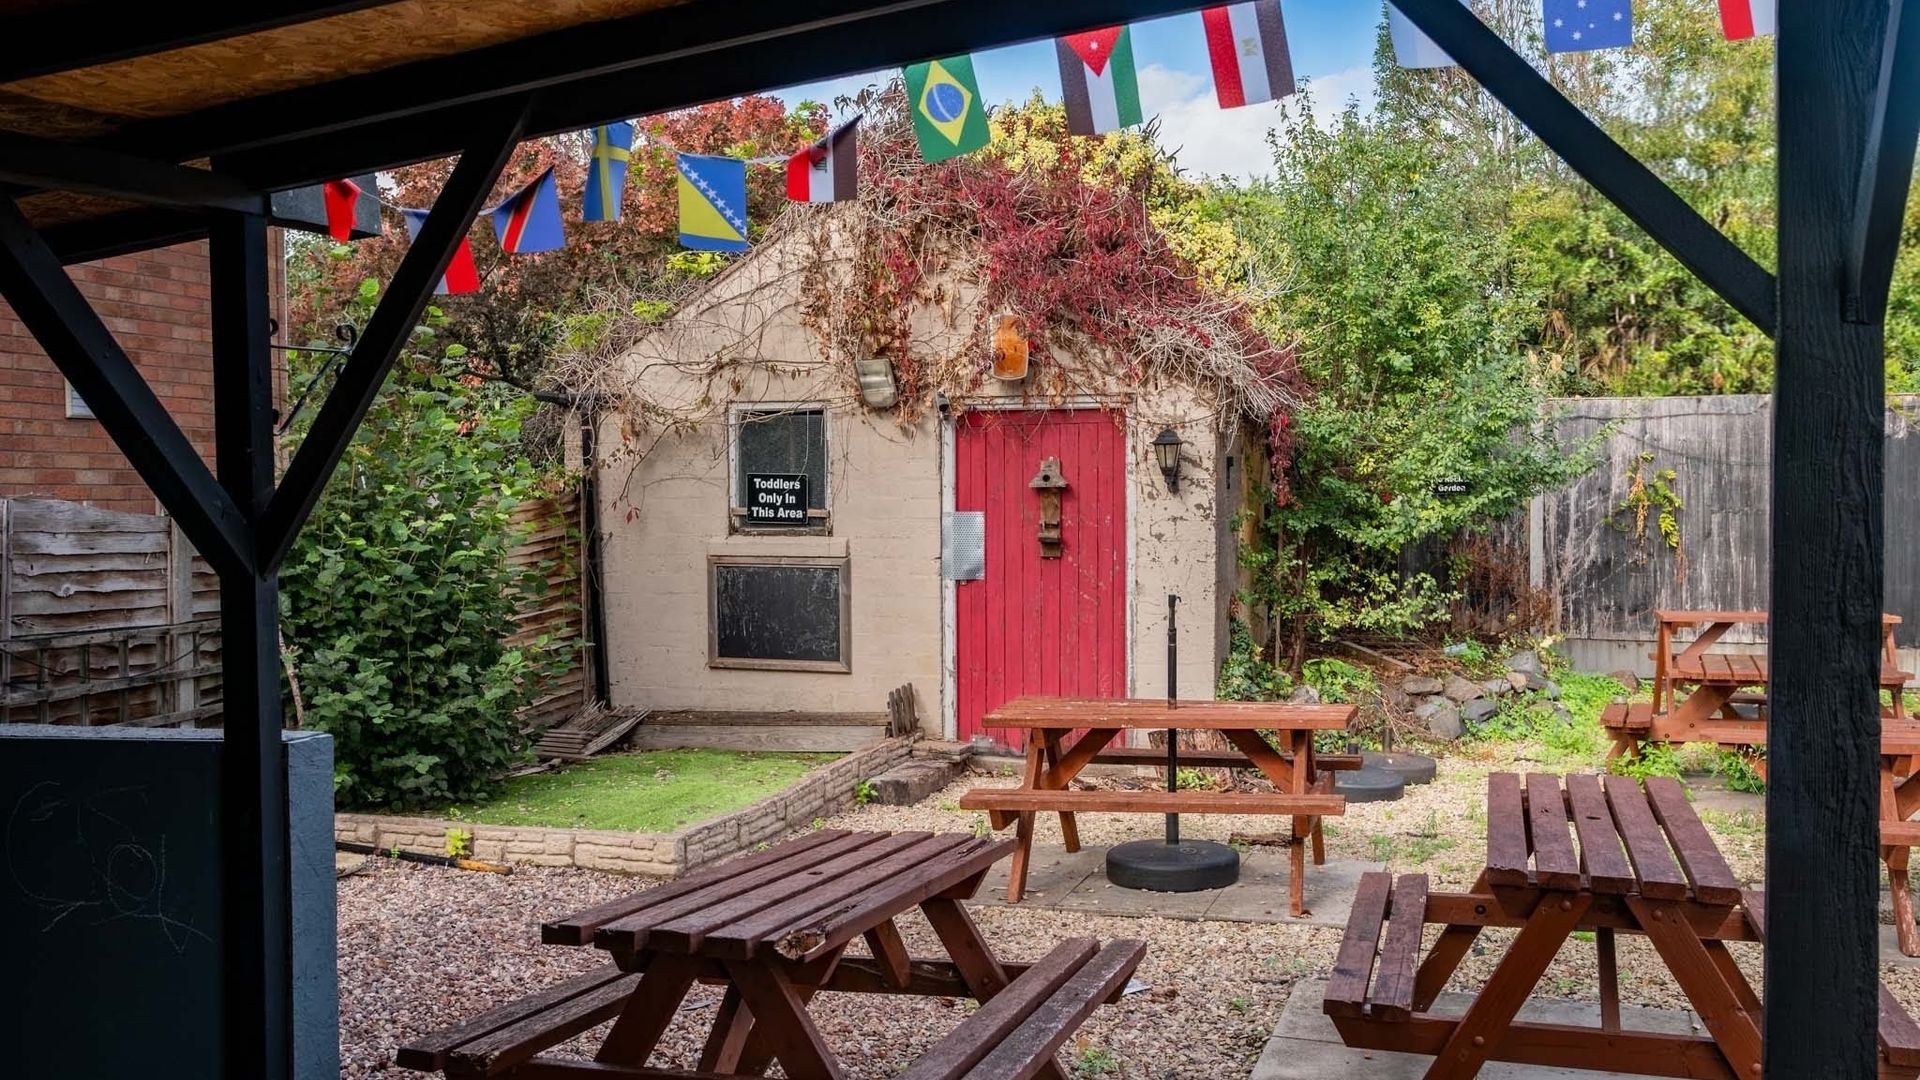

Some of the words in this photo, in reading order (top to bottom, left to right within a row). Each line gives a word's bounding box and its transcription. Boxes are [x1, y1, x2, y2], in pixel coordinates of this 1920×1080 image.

[753, 478, 801, 489] Toddlers
[758, 492, 783, 506] Only
[785, 493, 796, 504] In
[751, 506, 775, 518] This
[777, 507, 803, 519] Area
